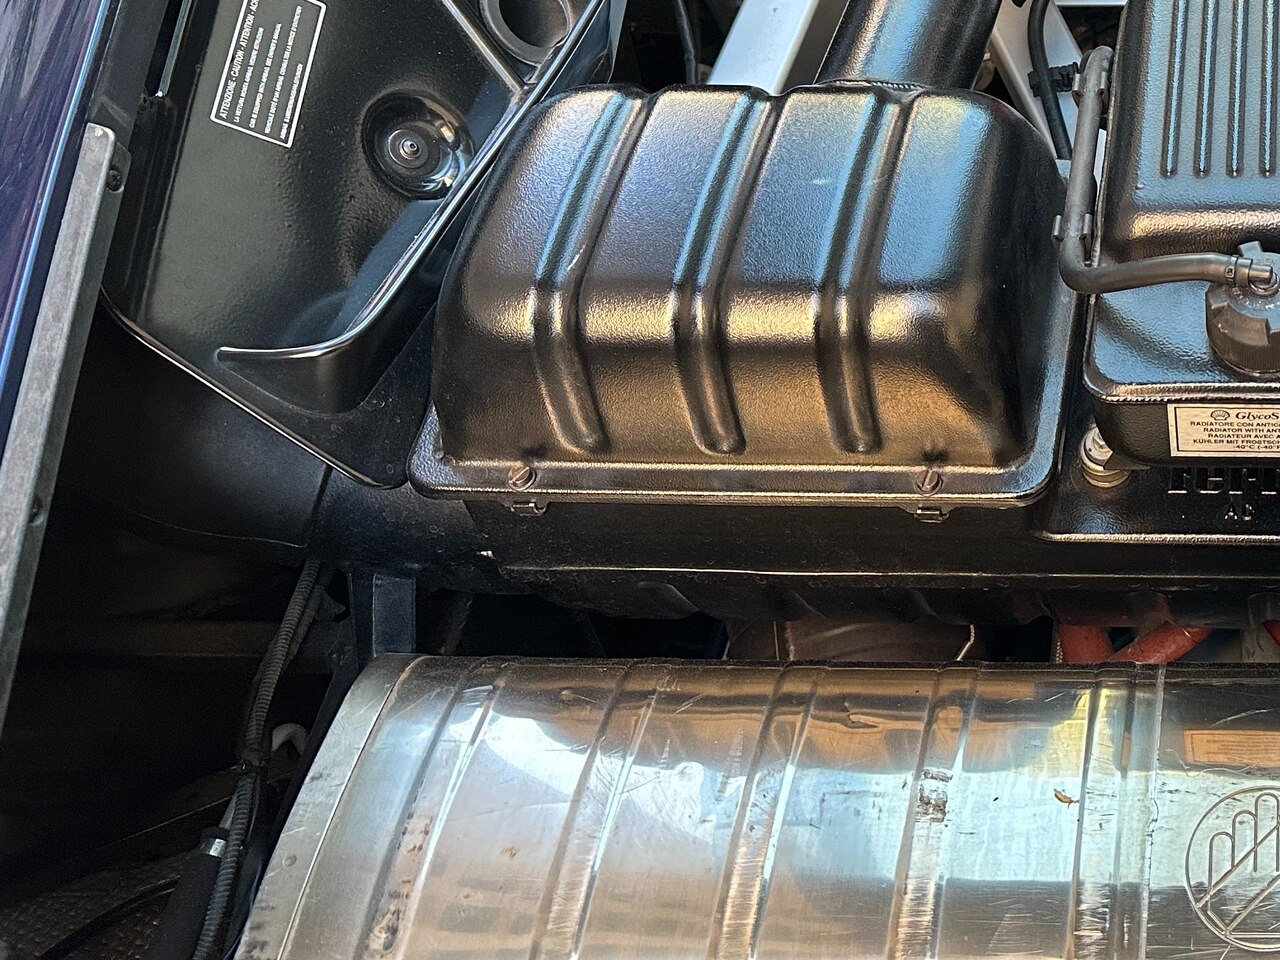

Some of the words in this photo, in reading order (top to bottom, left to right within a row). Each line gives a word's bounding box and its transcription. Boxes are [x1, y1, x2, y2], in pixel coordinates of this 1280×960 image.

[218, 79, 236, 118] ATTENZIONE
[230, 49, 245, 77] CAUTION
[239, 13, 255, 47] ATTENTION
